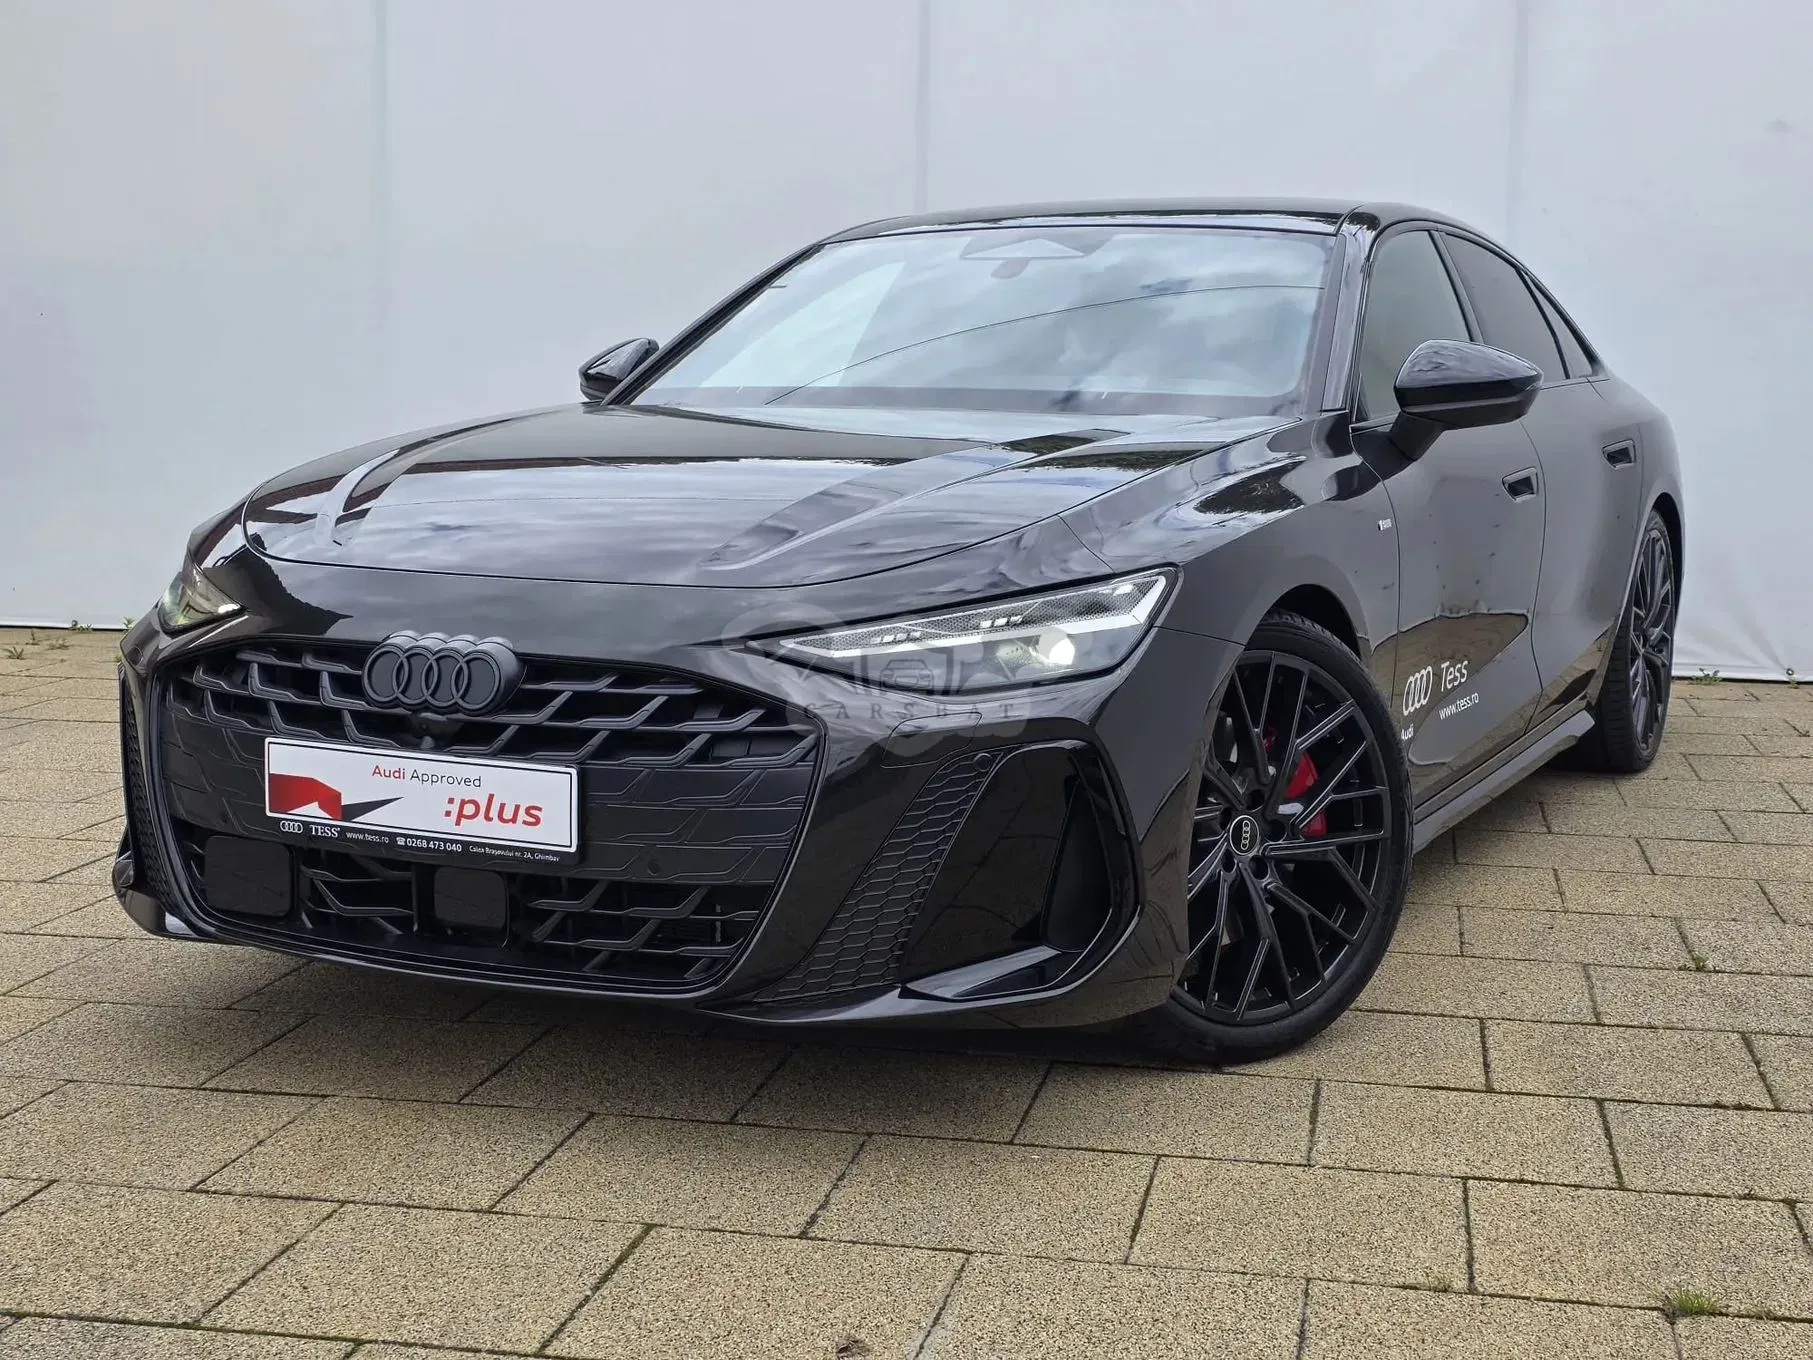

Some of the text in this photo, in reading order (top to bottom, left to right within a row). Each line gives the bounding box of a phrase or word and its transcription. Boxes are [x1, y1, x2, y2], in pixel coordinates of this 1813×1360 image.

[1440, 660, 1469, 692] Tess
[1438, 692, 1480, 720] www.tess.ro
[1400, 723, 1414, 741] Audi
[371, 765, 482, 788] Audi Approved
[444, 793, 543, 827] :plus
[310, 824, 341, 838] TESS
[345, 831, 389, 844] www.tess.ro
[406, 838, 428, 848] 0268
[428, 841, 445, 850] 473
[446, 843, 462, 853] 040
